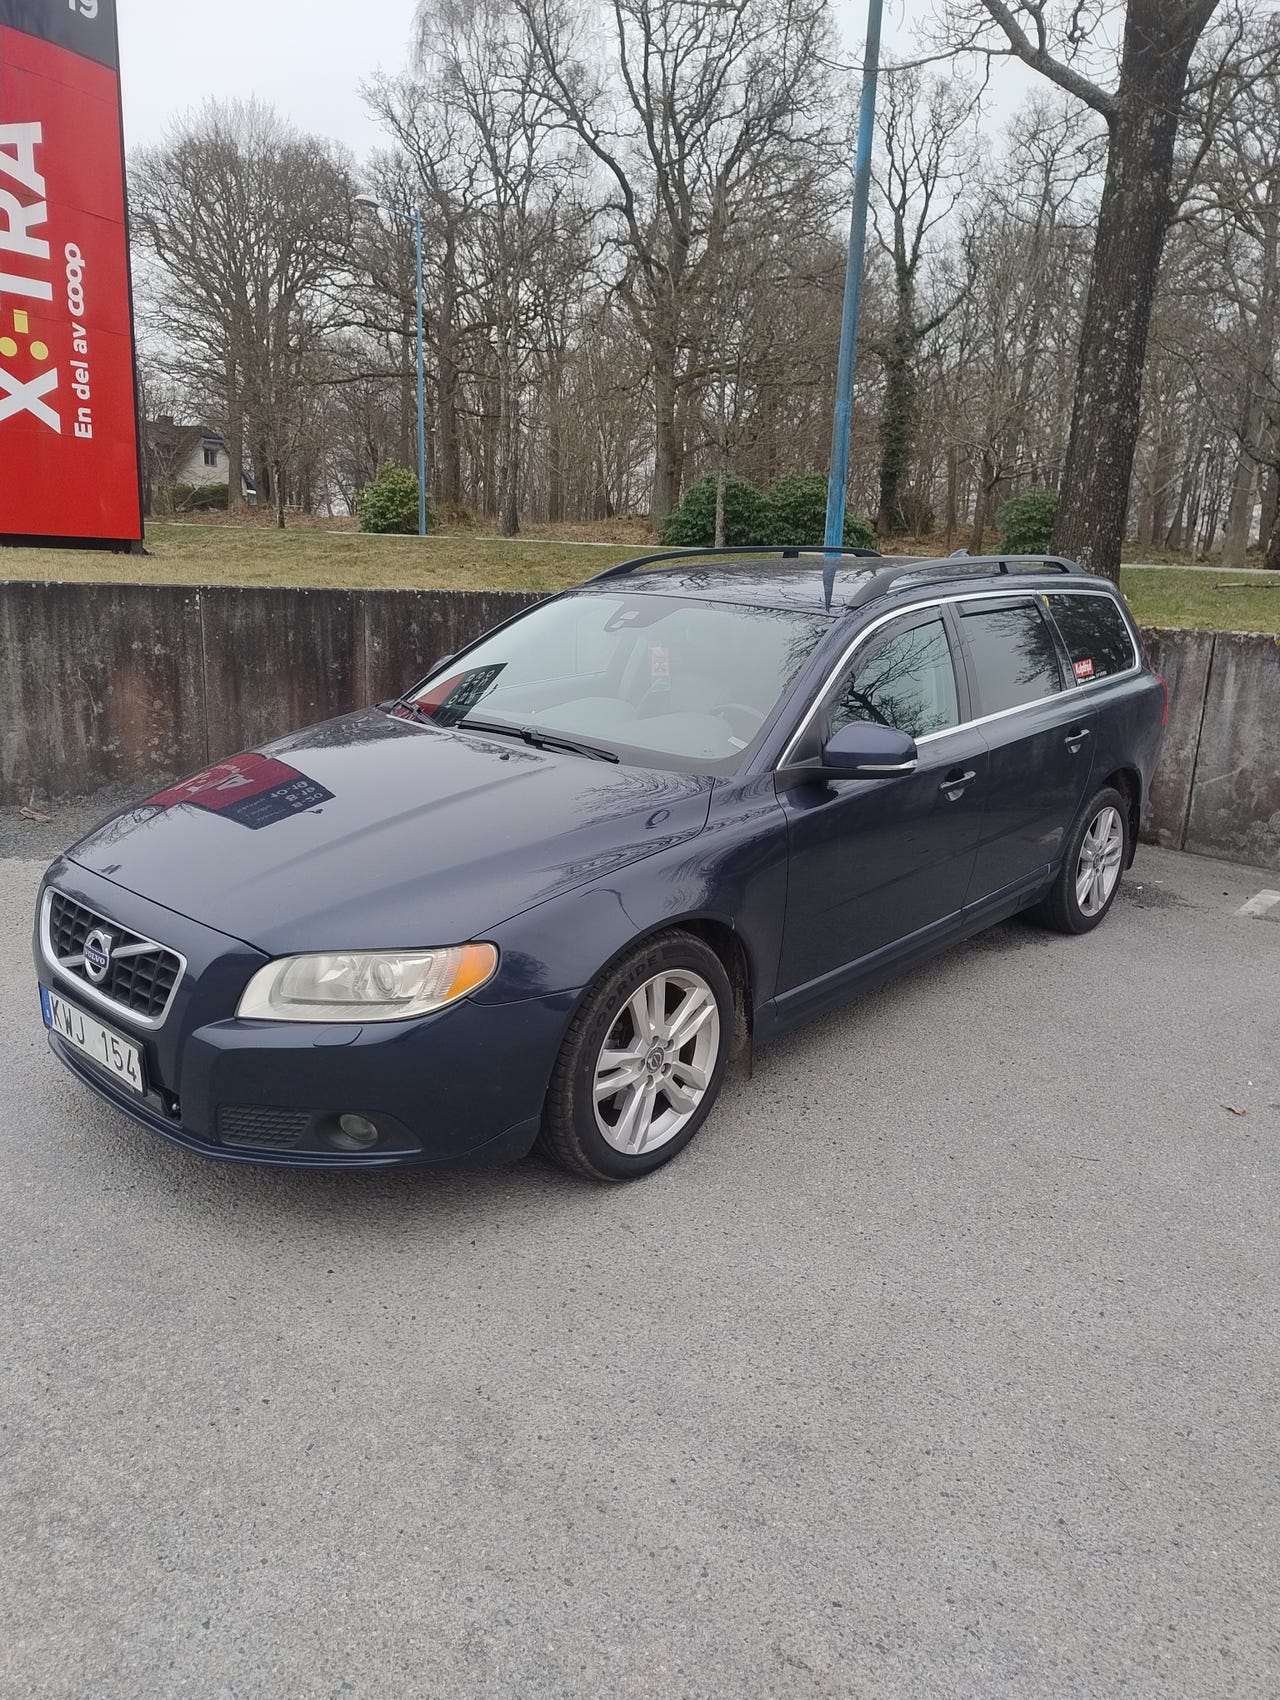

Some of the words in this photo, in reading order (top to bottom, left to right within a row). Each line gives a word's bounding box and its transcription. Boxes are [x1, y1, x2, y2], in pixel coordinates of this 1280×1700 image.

[64, 242, 86, 317] coop
[70, 322, 88, 355] av
[69, 360, 91, 401] del
[73, 408, 93, 439] En
[85, 951, 106, 965] VOLVO
[51, 996, 85, 1045] KWJ
[101, 1031, 137, 1082] 154
